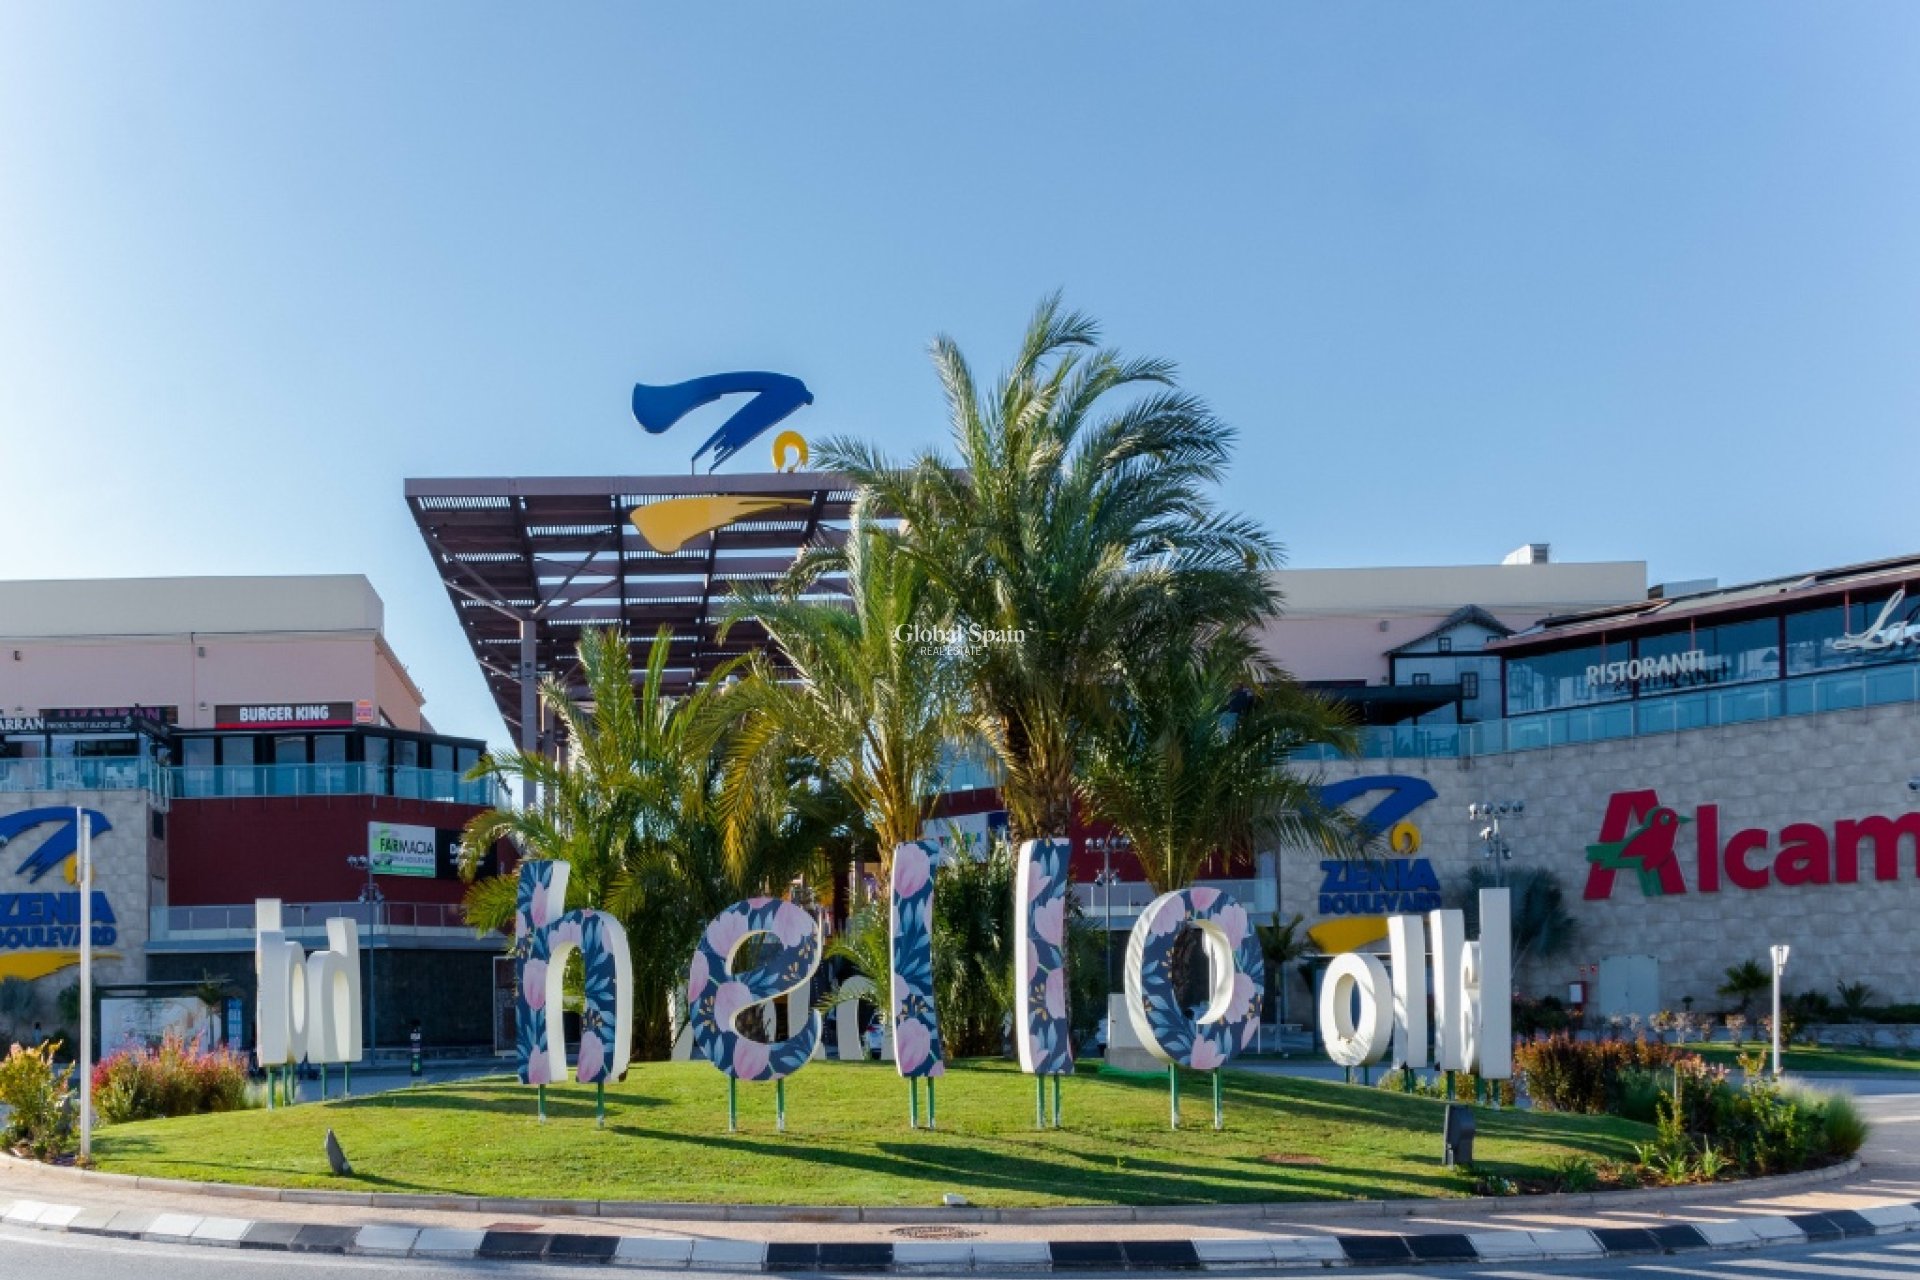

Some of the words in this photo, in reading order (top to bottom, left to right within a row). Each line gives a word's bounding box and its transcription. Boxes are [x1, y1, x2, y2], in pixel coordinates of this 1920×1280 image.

[239, 706, 293, 722] BURGER
[295, 705, 329, 721] KING
[379, 838, 434, 855] FARMACIA
[1319, 859, 1440, 892] ZENIA
[1317, 893, 1442, 915] BOULEVARD
[515, 836, 1265, 1085] hello
